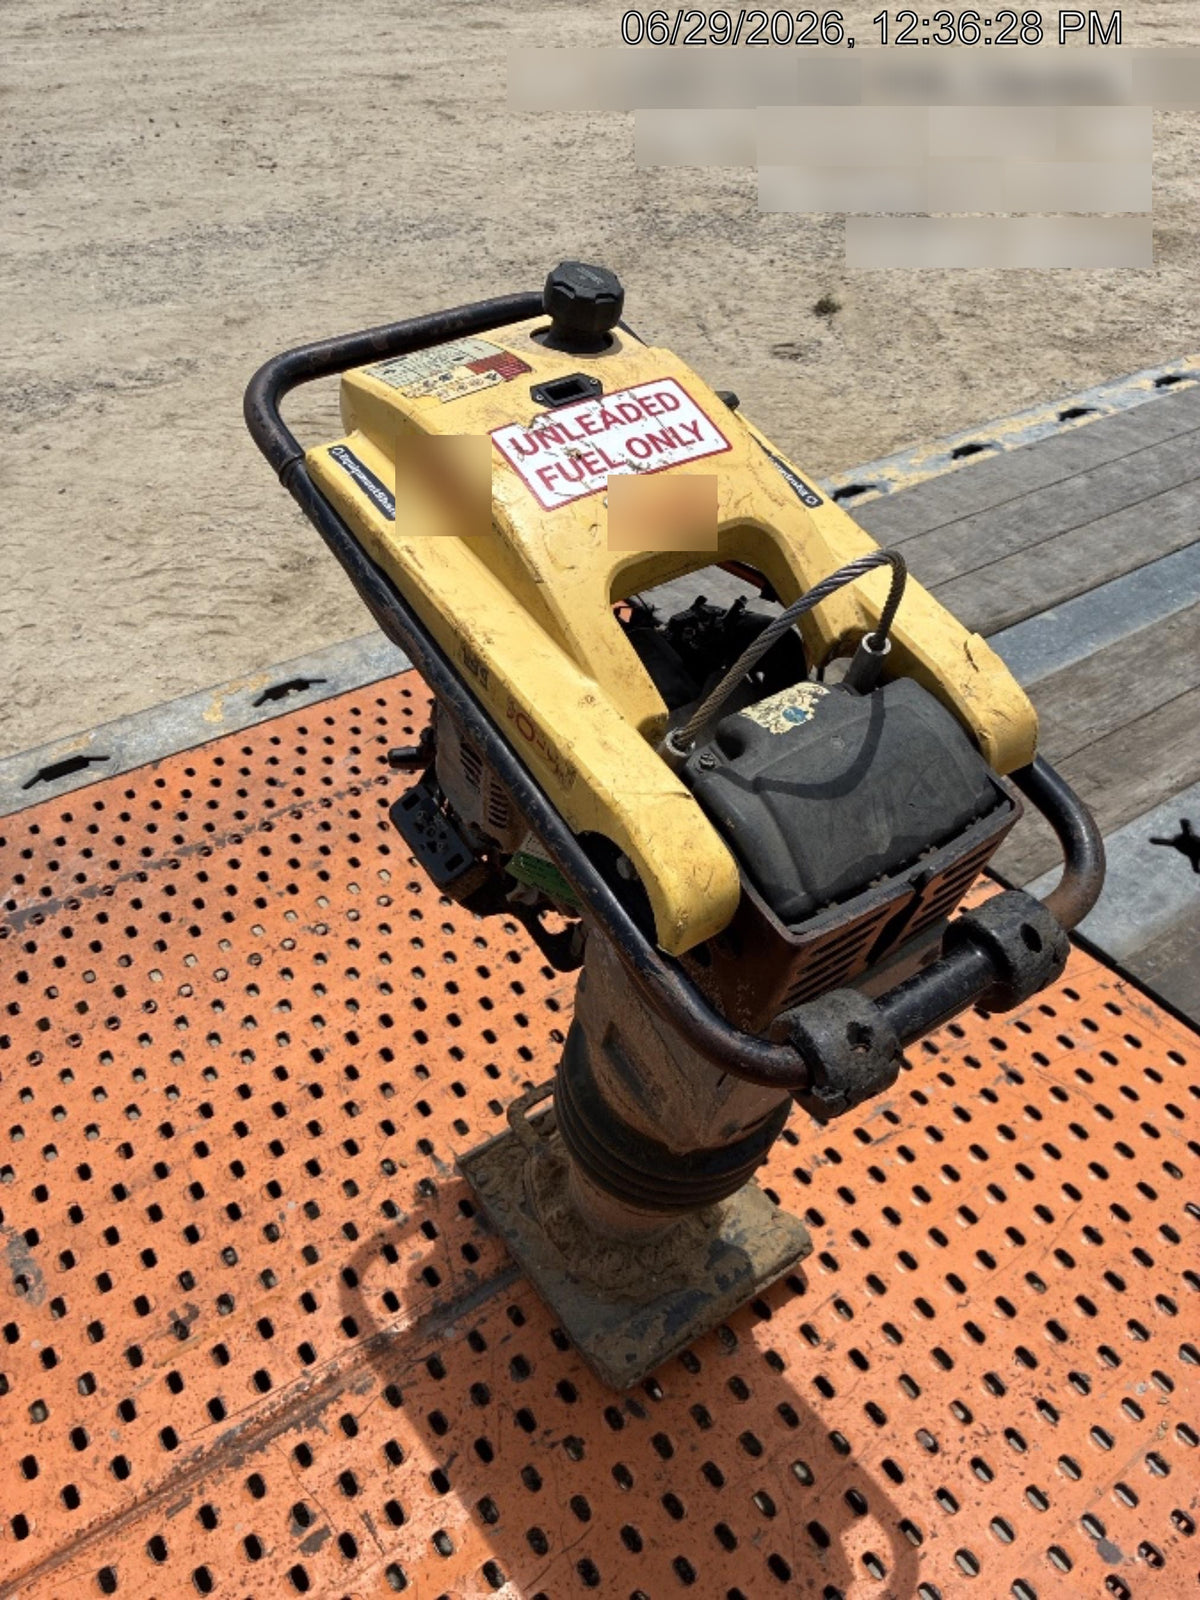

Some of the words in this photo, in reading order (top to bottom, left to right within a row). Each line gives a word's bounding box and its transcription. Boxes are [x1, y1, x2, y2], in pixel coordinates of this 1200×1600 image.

[508, 391, 681, 456] UNLEADED
[535, 443, 627, 491] FUEL
[624, 419, 705, 459] ONLY
